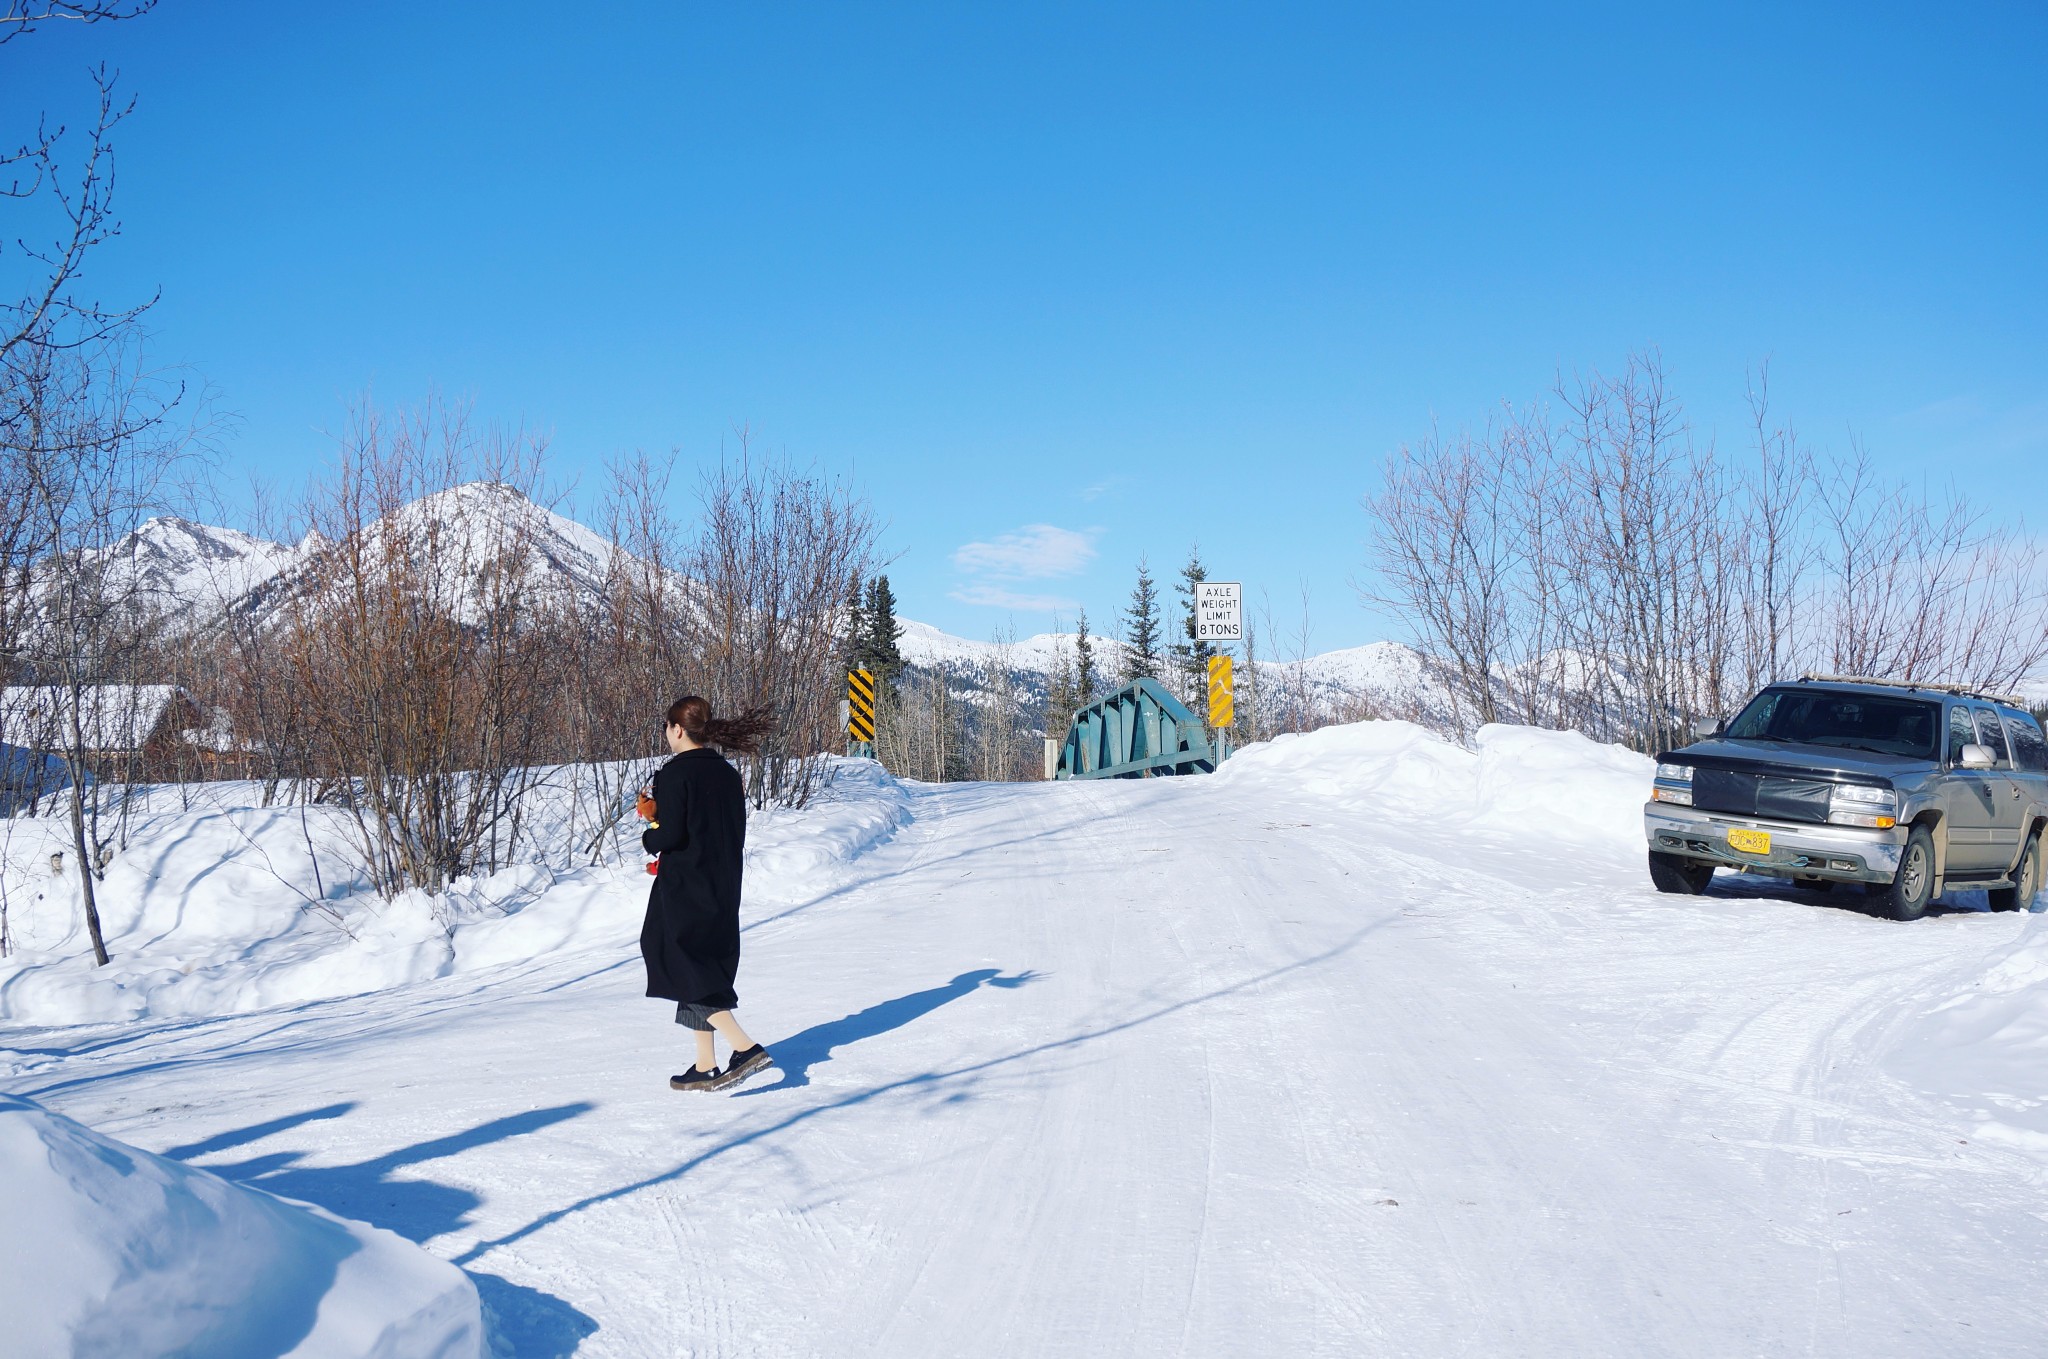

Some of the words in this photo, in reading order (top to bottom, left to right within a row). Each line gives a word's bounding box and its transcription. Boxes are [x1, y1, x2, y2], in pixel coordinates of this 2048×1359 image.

[1205, 588, 1231, 597] AXLE
[1201, 600, 1237, 609] WEIGHT
[1206, 612, 1231, 621] LIMIT
[1199, 624, 1207, 635] 8
[1209, 624, 1239, 635] TONS
[1752, 836, 1769, 848] 837
